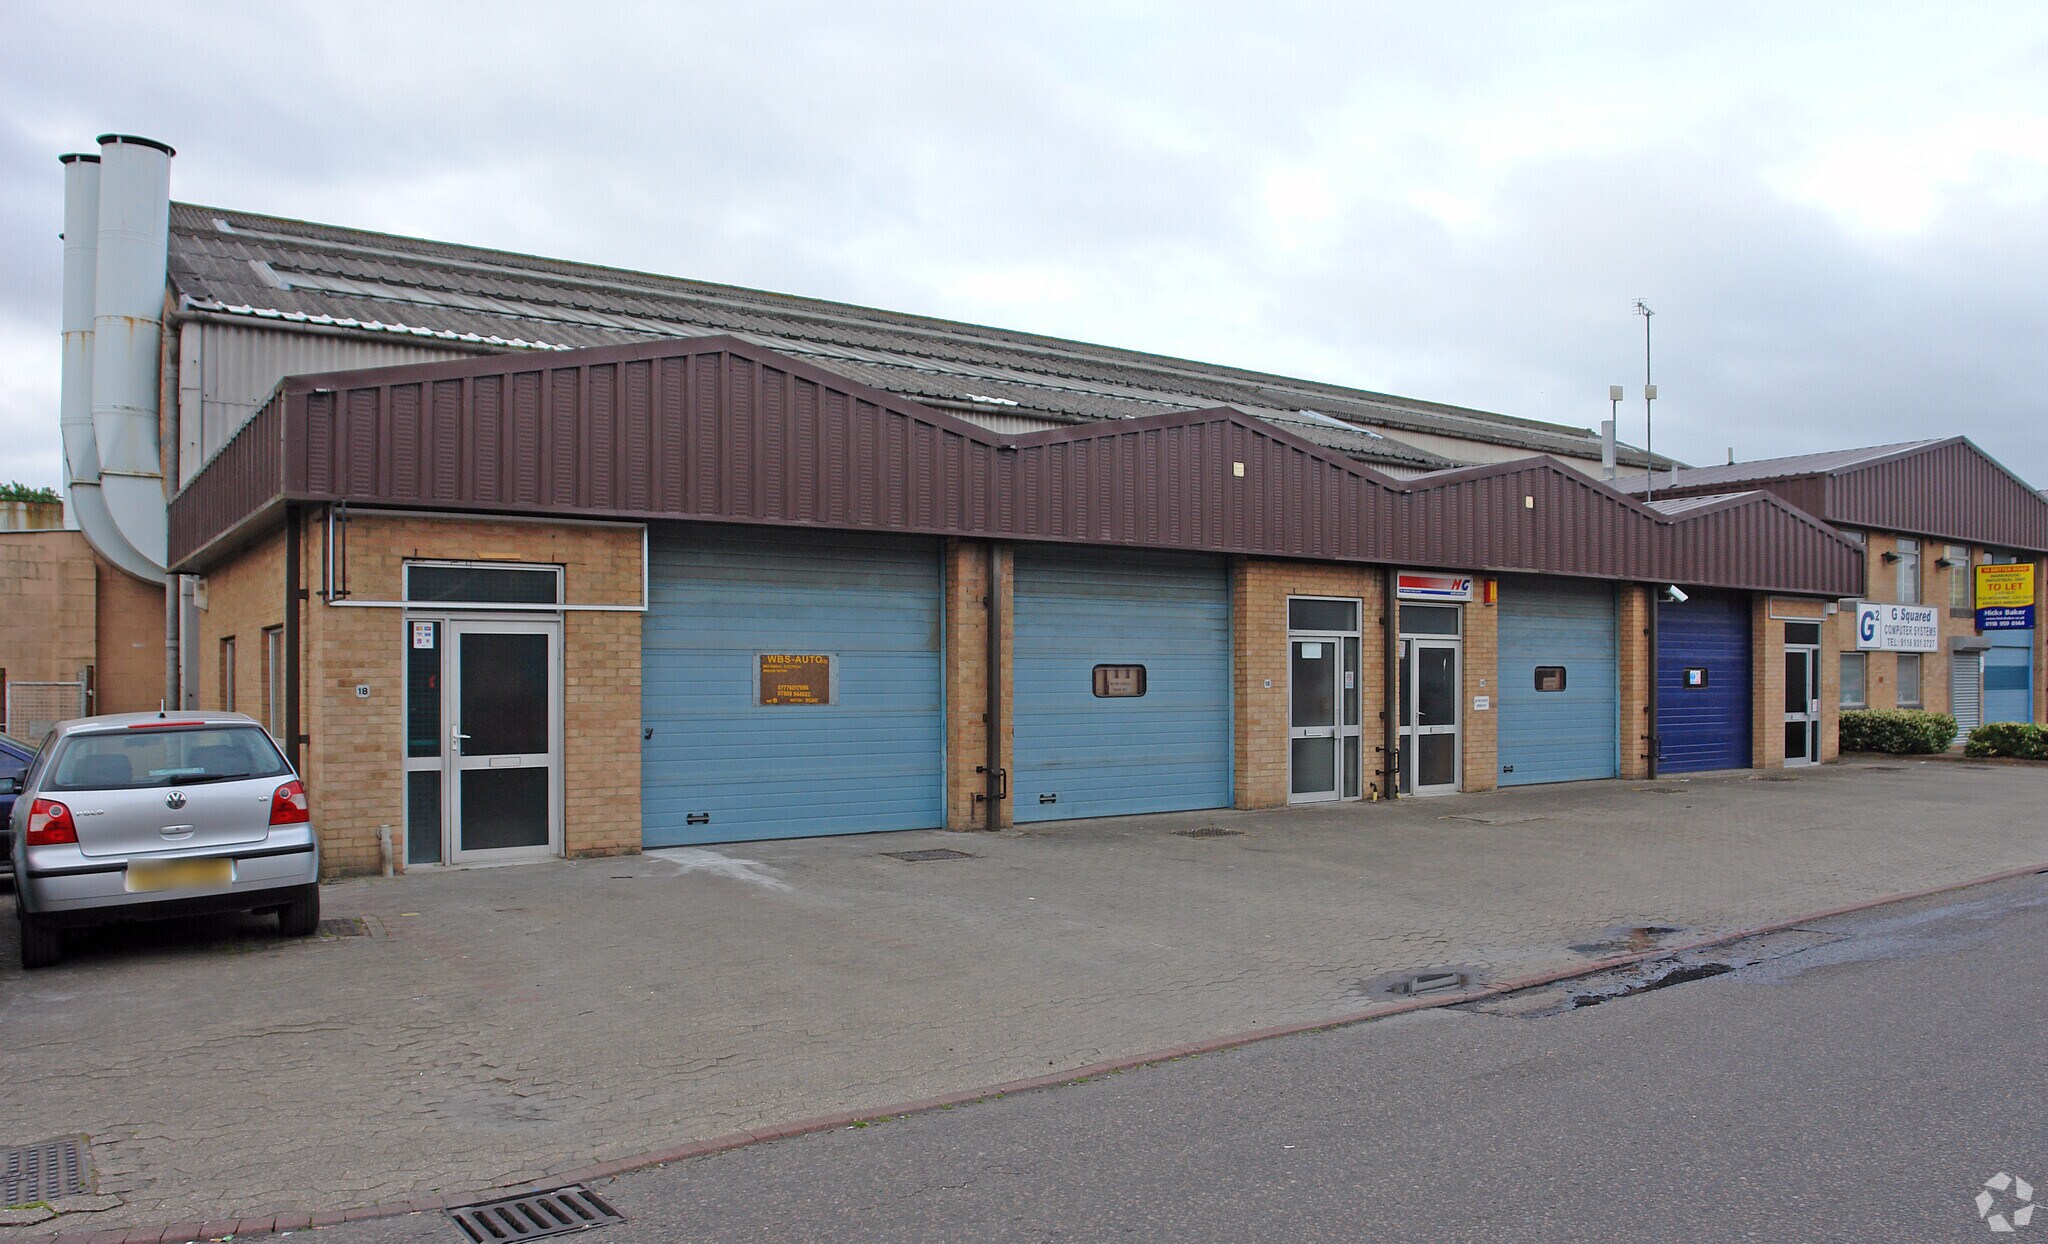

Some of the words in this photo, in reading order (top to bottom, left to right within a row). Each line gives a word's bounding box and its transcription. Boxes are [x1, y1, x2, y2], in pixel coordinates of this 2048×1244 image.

[1892, 608, 1898, 620] G
[1901, 607, 1932, 624] Squared
[1884, 624, 1912, 636] COMPUTER
[1914, 626, 1936, 636] SYSTEMS
[1902, 638, 1912, 646] 0118
[1924, 640, 1936, 648] 2727
[768, 656, 822, 664] WBS-AUTO
